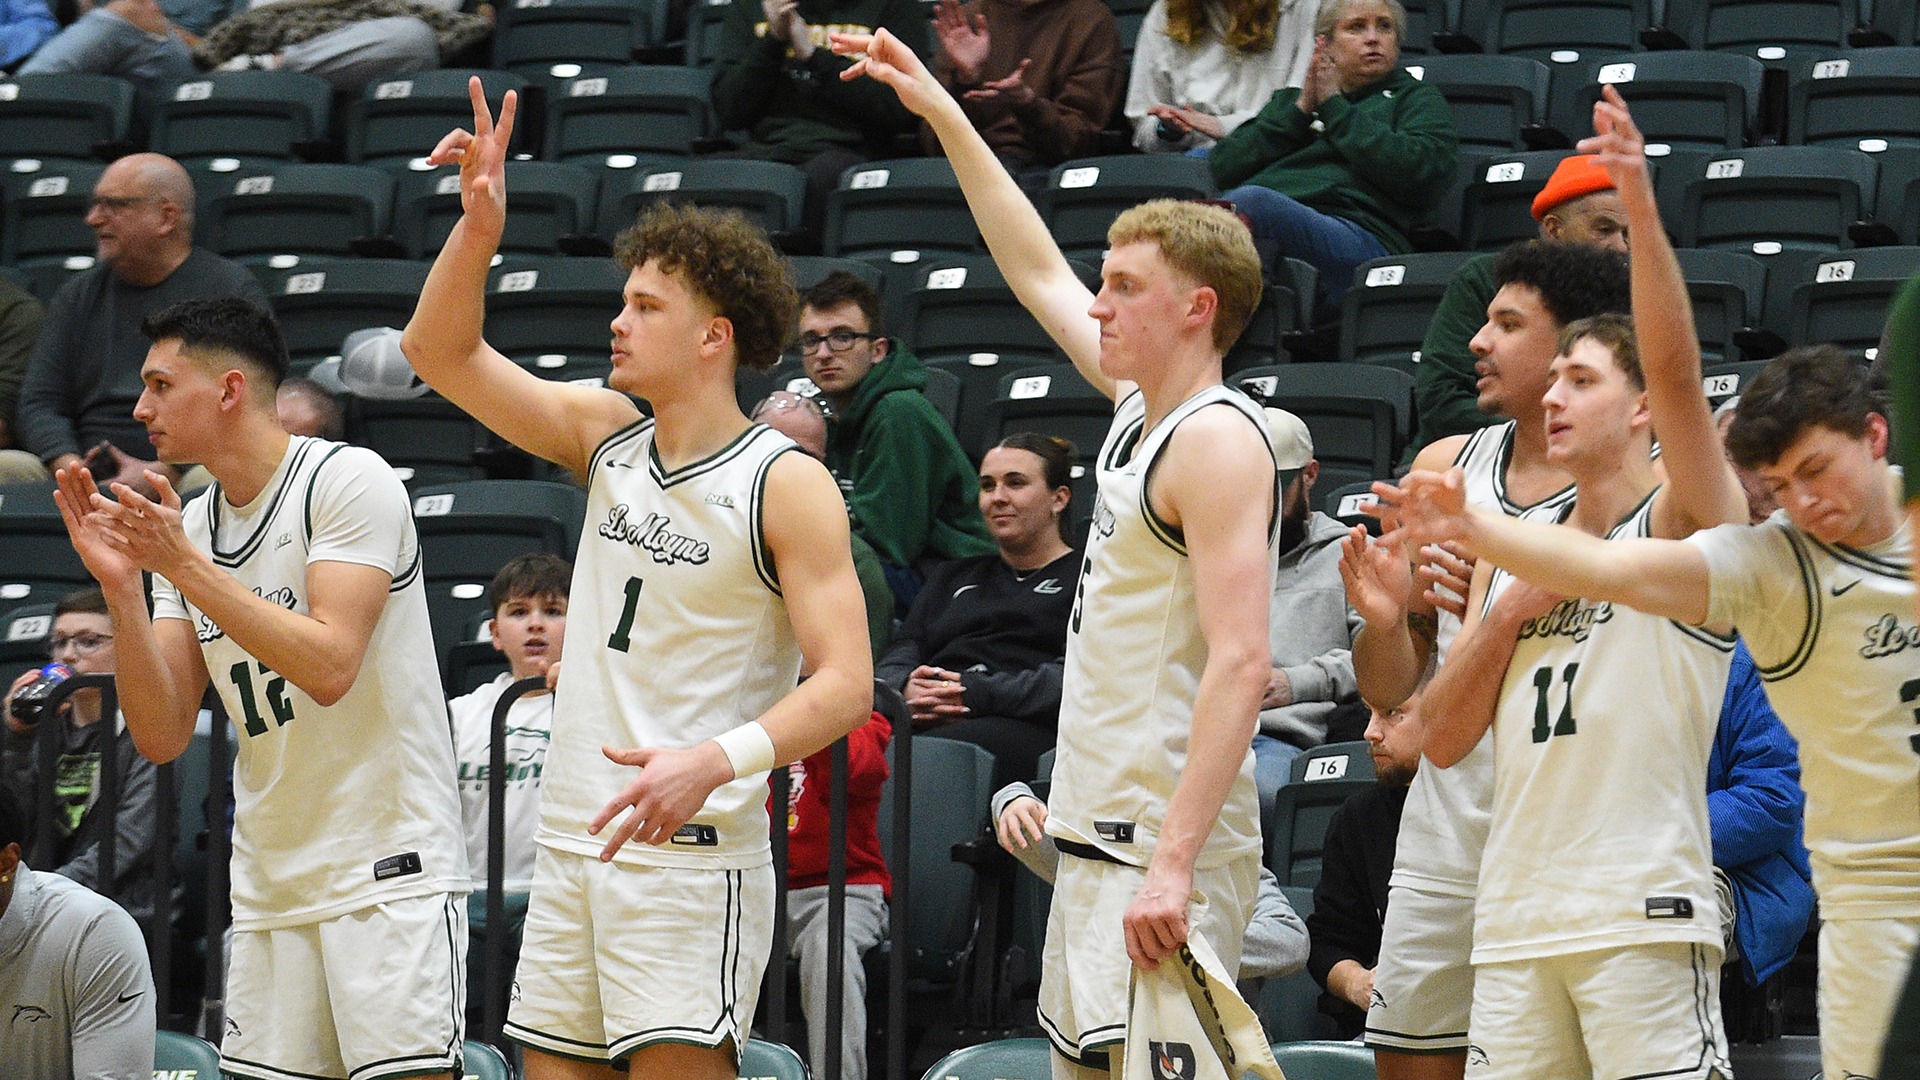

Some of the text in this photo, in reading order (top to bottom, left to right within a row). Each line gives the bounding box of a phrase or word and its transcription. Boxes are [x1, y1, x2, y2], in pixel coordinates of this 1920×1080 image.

[1825, 63, 1841, 77] 17
[1719, 163, 1735, 177] 17
[1829, 265, 1845, 280] 16
[1712, 379, 1729, 392] 16
[607, 576, 643, 653] 1
[20, 621, 41, 635] 22
[230, 661, 295, 738] 12
[1532, 662, 1580, 743] 11
[1319, 760, 1337, 776] 16
[703, 830, 710, 840] L
[1120, 827, 1126, 837] L
[406, 858, 413, 868] L
